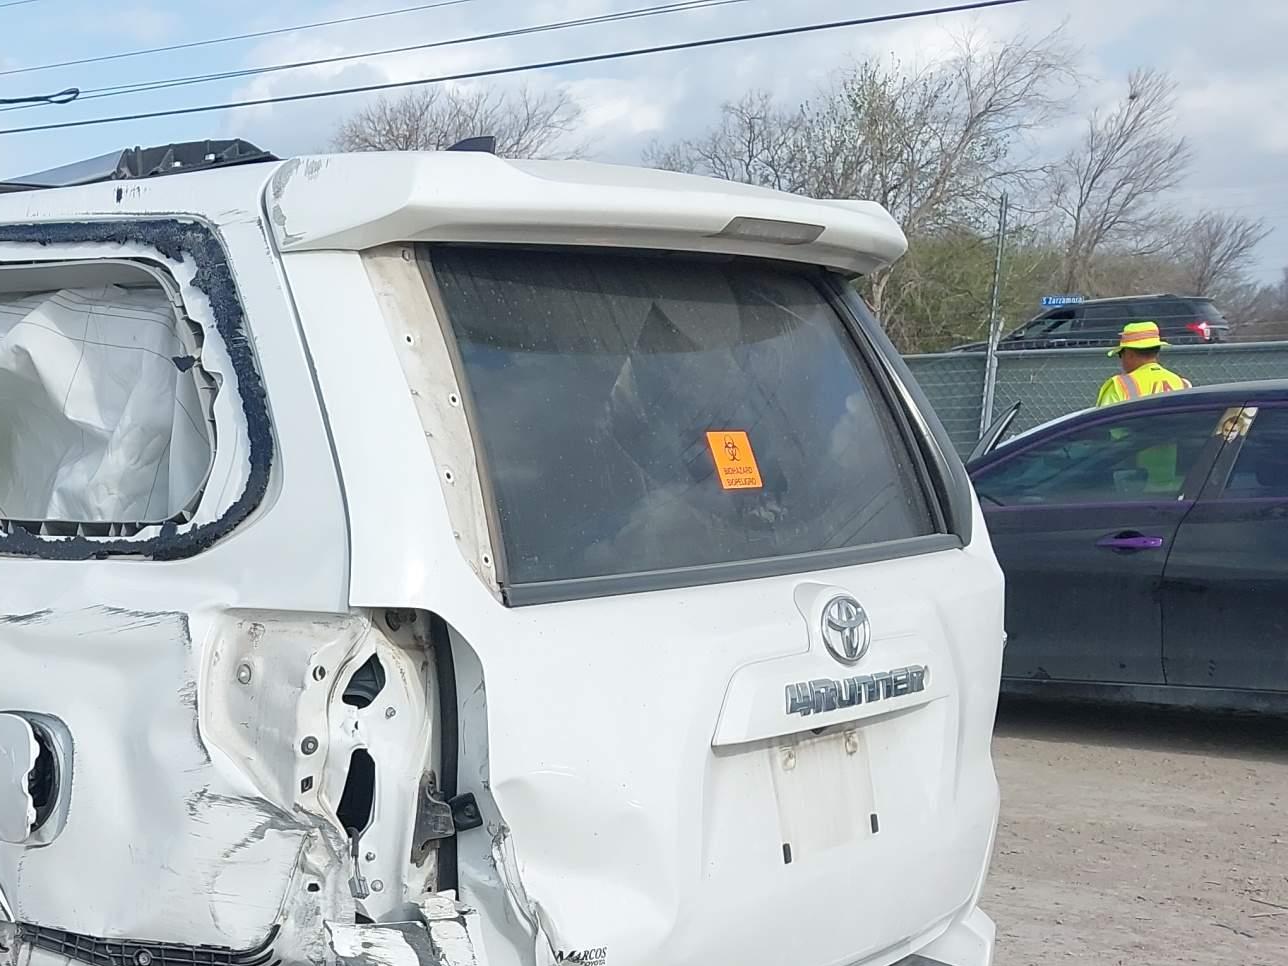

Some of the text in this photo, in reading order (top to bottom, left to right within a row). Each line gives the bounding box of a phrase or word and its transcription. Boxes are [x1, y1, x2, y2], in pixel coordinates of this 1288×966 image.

[723, 466, 753, 475] BIOHAZARD
[785, 665, 927, 717] 4RUNNER
[580, 959, 606, 966] TOYOTA
